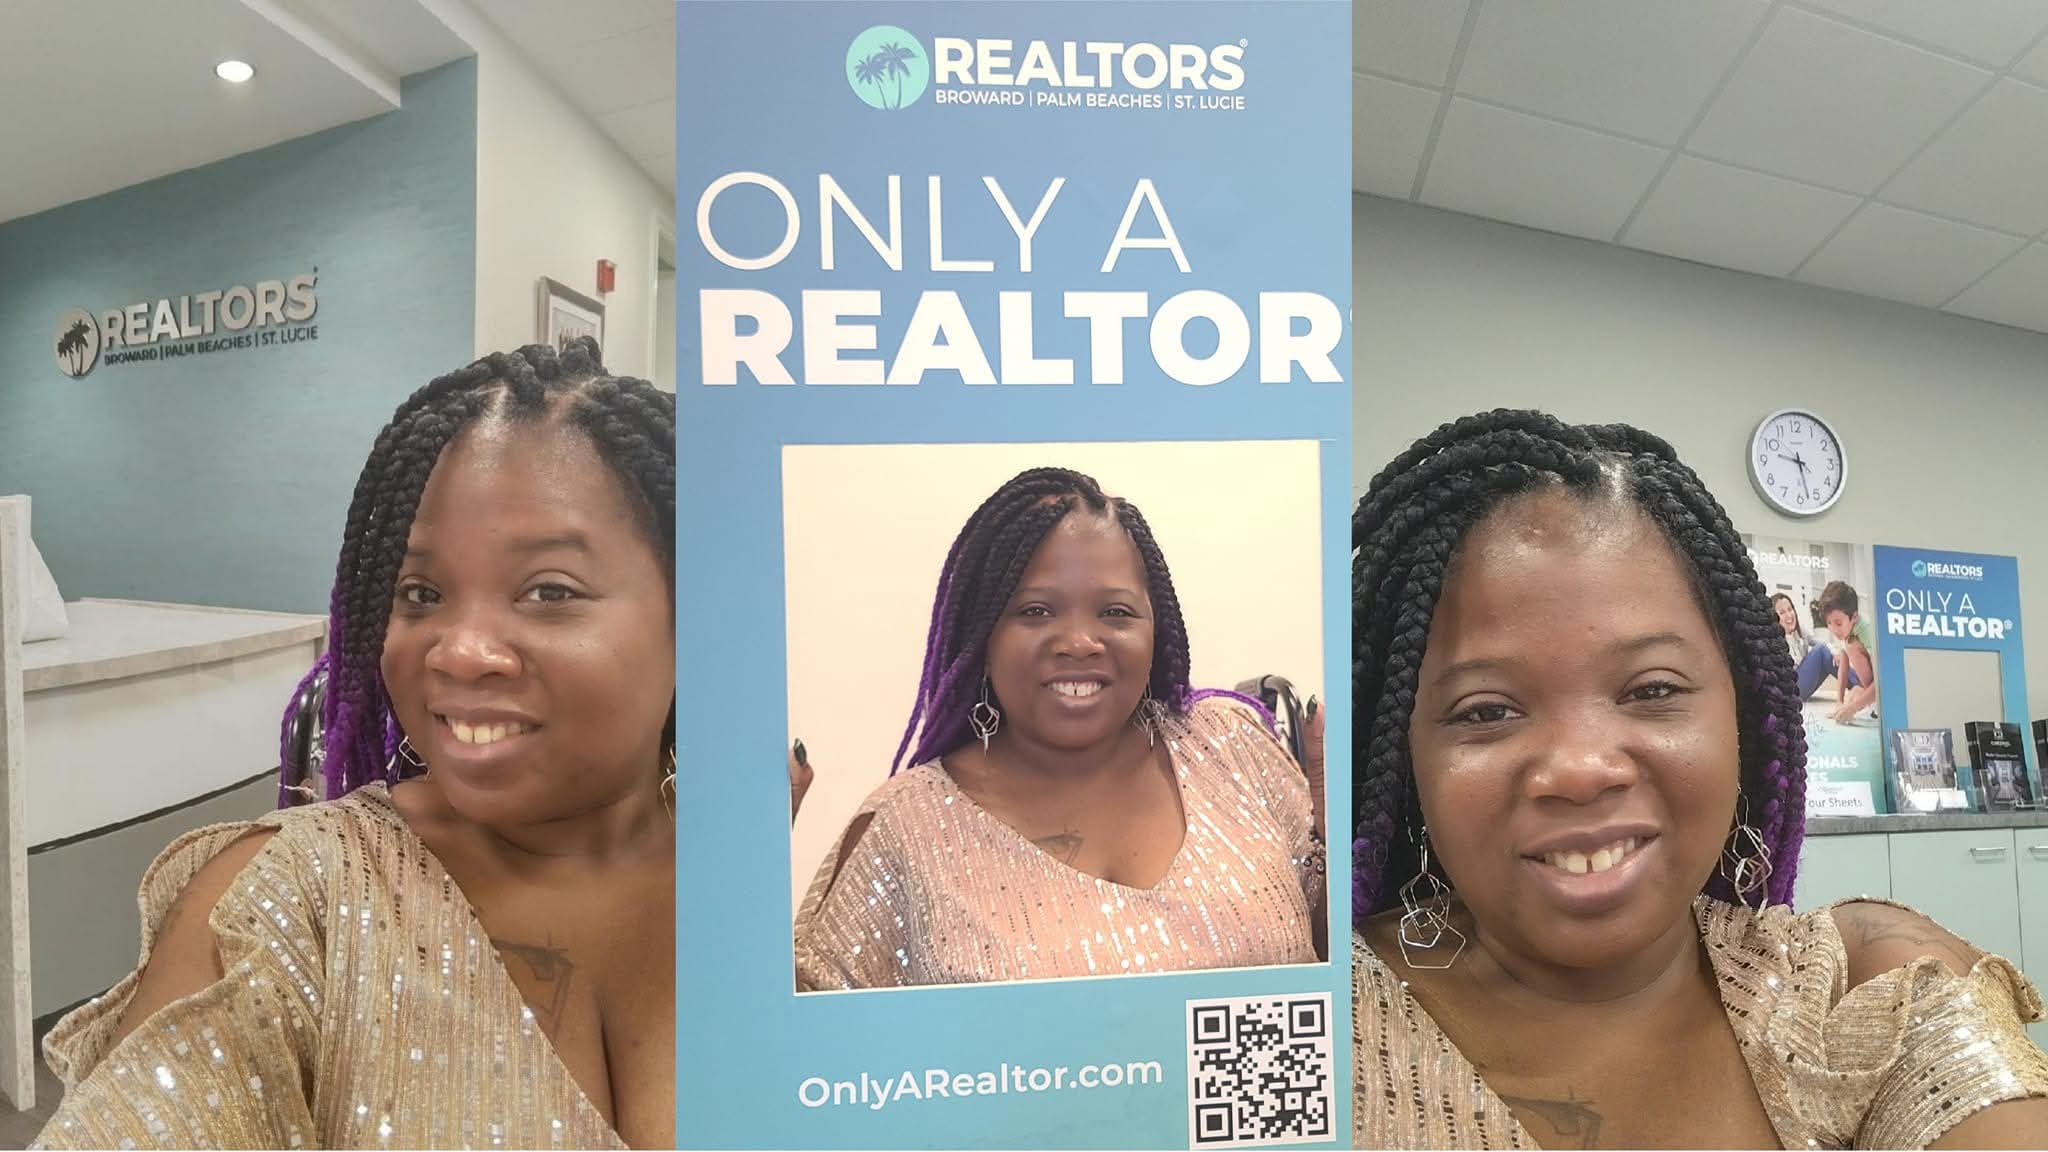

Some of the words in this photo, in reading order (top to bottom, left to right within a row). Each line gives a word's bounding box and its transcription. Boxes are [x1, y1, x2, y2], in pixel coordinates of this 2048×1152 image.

[935, 89, 1025, 105] BROWARD
[1036, 91, 1081, 107] PALM
[1086, 93, 1162, 108] BEACHES
[1174, 95, 1196, 109] ST.
[1199, 96, 1246, 110] LUCIE
[696, 171, 1066, 272] ONLY
[1100, 178, 1193, 273] A
[700, 289, 1352, 386] REALTOR
[105, 347, 158, 366] BROWARD
[165, 342, 195, 358] PALM
[198, 334, 252, 353] BEACHES
[262, 331, 278, 345] ST.
[281, 326, 318, 344] LUCIE
[1776, 425, 1784, 437] 11
[1789, 420, 1800, 433] 12
[1764, 438, 1780, 451] 10
[1820, 440, 1828, 451] 2
[1760, 454, 1768, 466] 9
[1826, 458, 1834, 470] 3
[1766, 473, 1775, 486] 8
[1823, 475, 1831, 487] 4
[1780, 486, 1788, 498] 7
[1812, 488, 1820, 500] 5
[1796, 494, 1804, 505] 6
[1760, 551, 1830, 569] REALTORS
[1927, 562, 1983, 577] REALTORS
[1886, 588, 1953, 613] ONLY
[1958, 592, 1976, 615] A
[1807, 755, 1857, 769] ONALS
[1808, 799, 1826, 808] our
[798, 1060, 1163, 1109] OnlyARealtor.com
